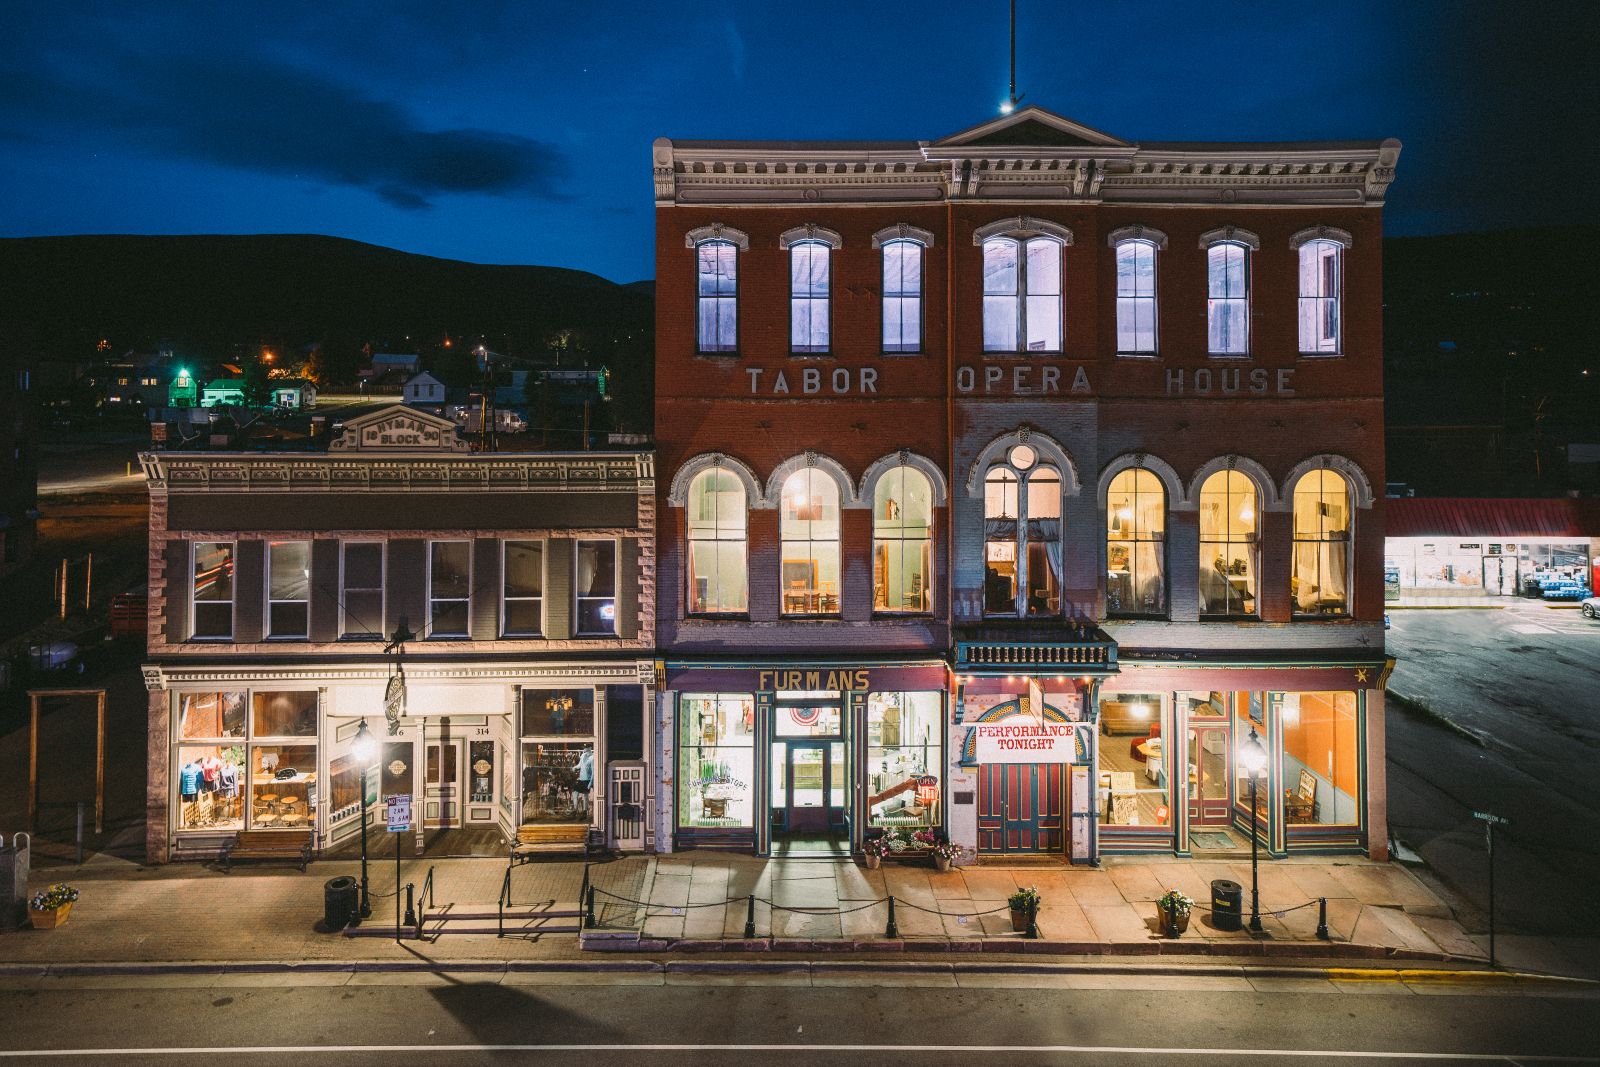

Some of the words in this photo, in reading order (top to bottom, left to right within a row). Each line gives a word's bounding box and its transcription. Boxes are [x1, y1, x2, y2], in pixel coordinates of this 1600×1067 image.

[746, 368, 877, 394] TABOR
[956, 366, 1093, 394] OPERA
[1166, 368, 1296, 394] HOUSE
[378, 420, 425, 433] HYMAN
[381, 435, 421, 444] BLOCK
[760, 670, 870, 691] FURMANS
[476, 728, 489, 736] 314
[978, 725, 1074, 738] PERFORMANCE
[997, 739, 1055, 750] TONIGHT
[919, 777, 936, 785] OPEN
